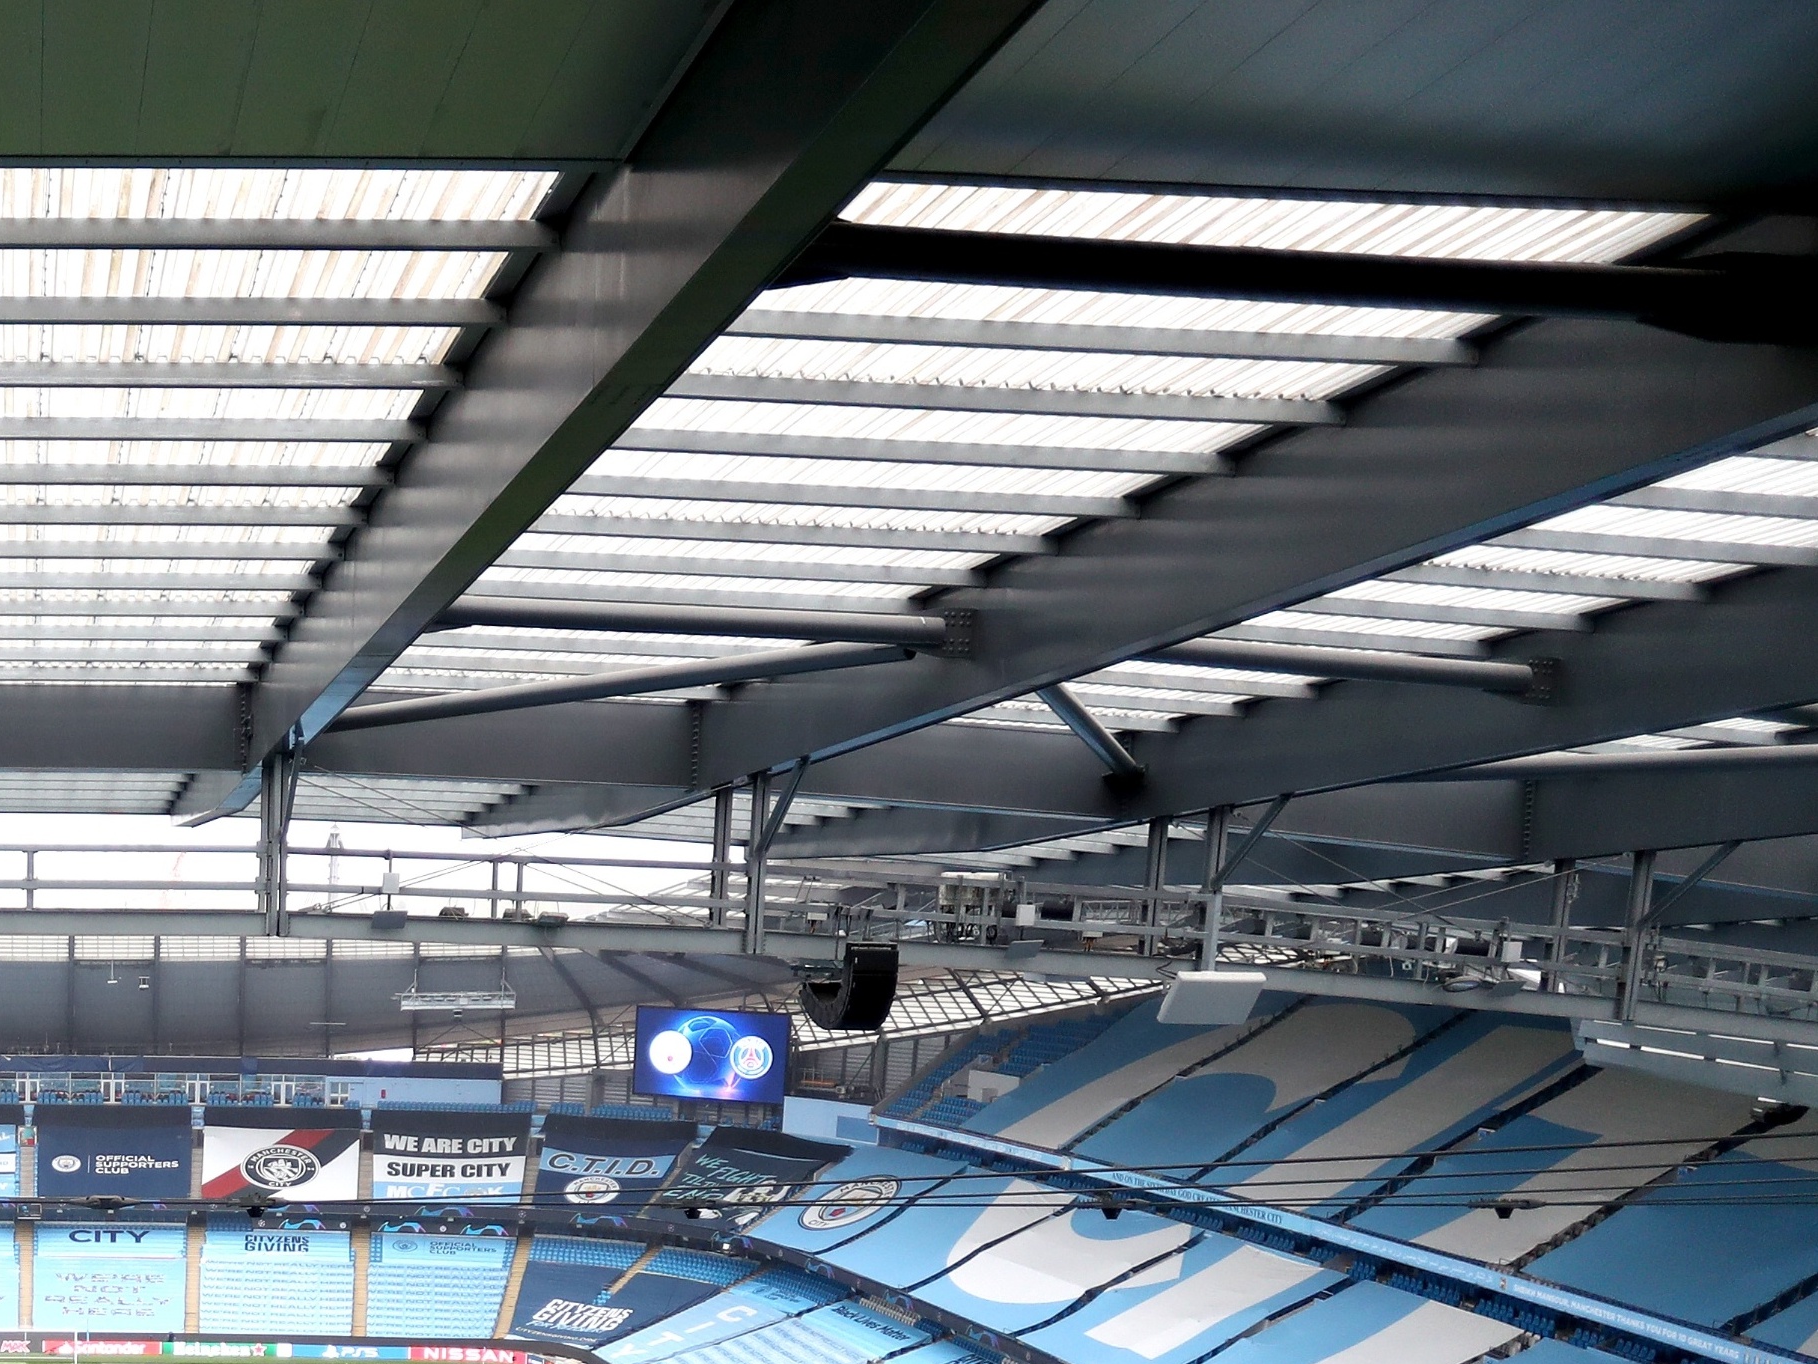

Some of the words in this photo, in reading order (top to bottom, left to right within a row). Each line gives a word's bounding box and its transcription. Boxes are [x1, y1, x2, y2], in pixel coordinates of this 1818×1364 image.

[383, 1133, 418, 1151] WE
[421, 1138, 463, 1154] ARE
[467, 1136, 518, 1154] CITY
[253, 1148, 312, 1163] MANCHESTER
[695, 1153, 729, 1170] WE
[95, 1161, 179, 1169] SUPPORTERS
[95, 1167, 130, 1175] CLUB
[387, 1162, 455, 1178] SUPER
[461, 1162, 511, 1178] CITY
[547, 1152, 660, 1176] C.T.I.D.
[708, 1166, 773, 1186] FIGHT
[1112, 1173, 1124, 1183] AND
[1178, 1190, 1192, 1200] GOD
[1266, 1213, 1283, 1224] CITY
[69, 1230, 150, 1243] CITY
[244, 1235, 310, 1243] CITYZENS
[244, 1242, 309, 1252] GIVING
[545, 1298, 634, 1320] CITYZENS
[533, 1308, 624, 1332] GIVING
[831, 1305, 859, 1322] Black
[856, 1312, 881, 1331] Lives
[877, 1324, 912, 1341] Matter
[1617, 1314, 1645, 1331] THANKS
[1687, 1335, 1714, 1350] GREAT
[1714, 1343, 1740, 1360] YEARS
[74, 1341, 145, 1355] Santander
[341, 1347, 379, 1358] PS5
[424, 1347, 514, 1363] NISSAN
